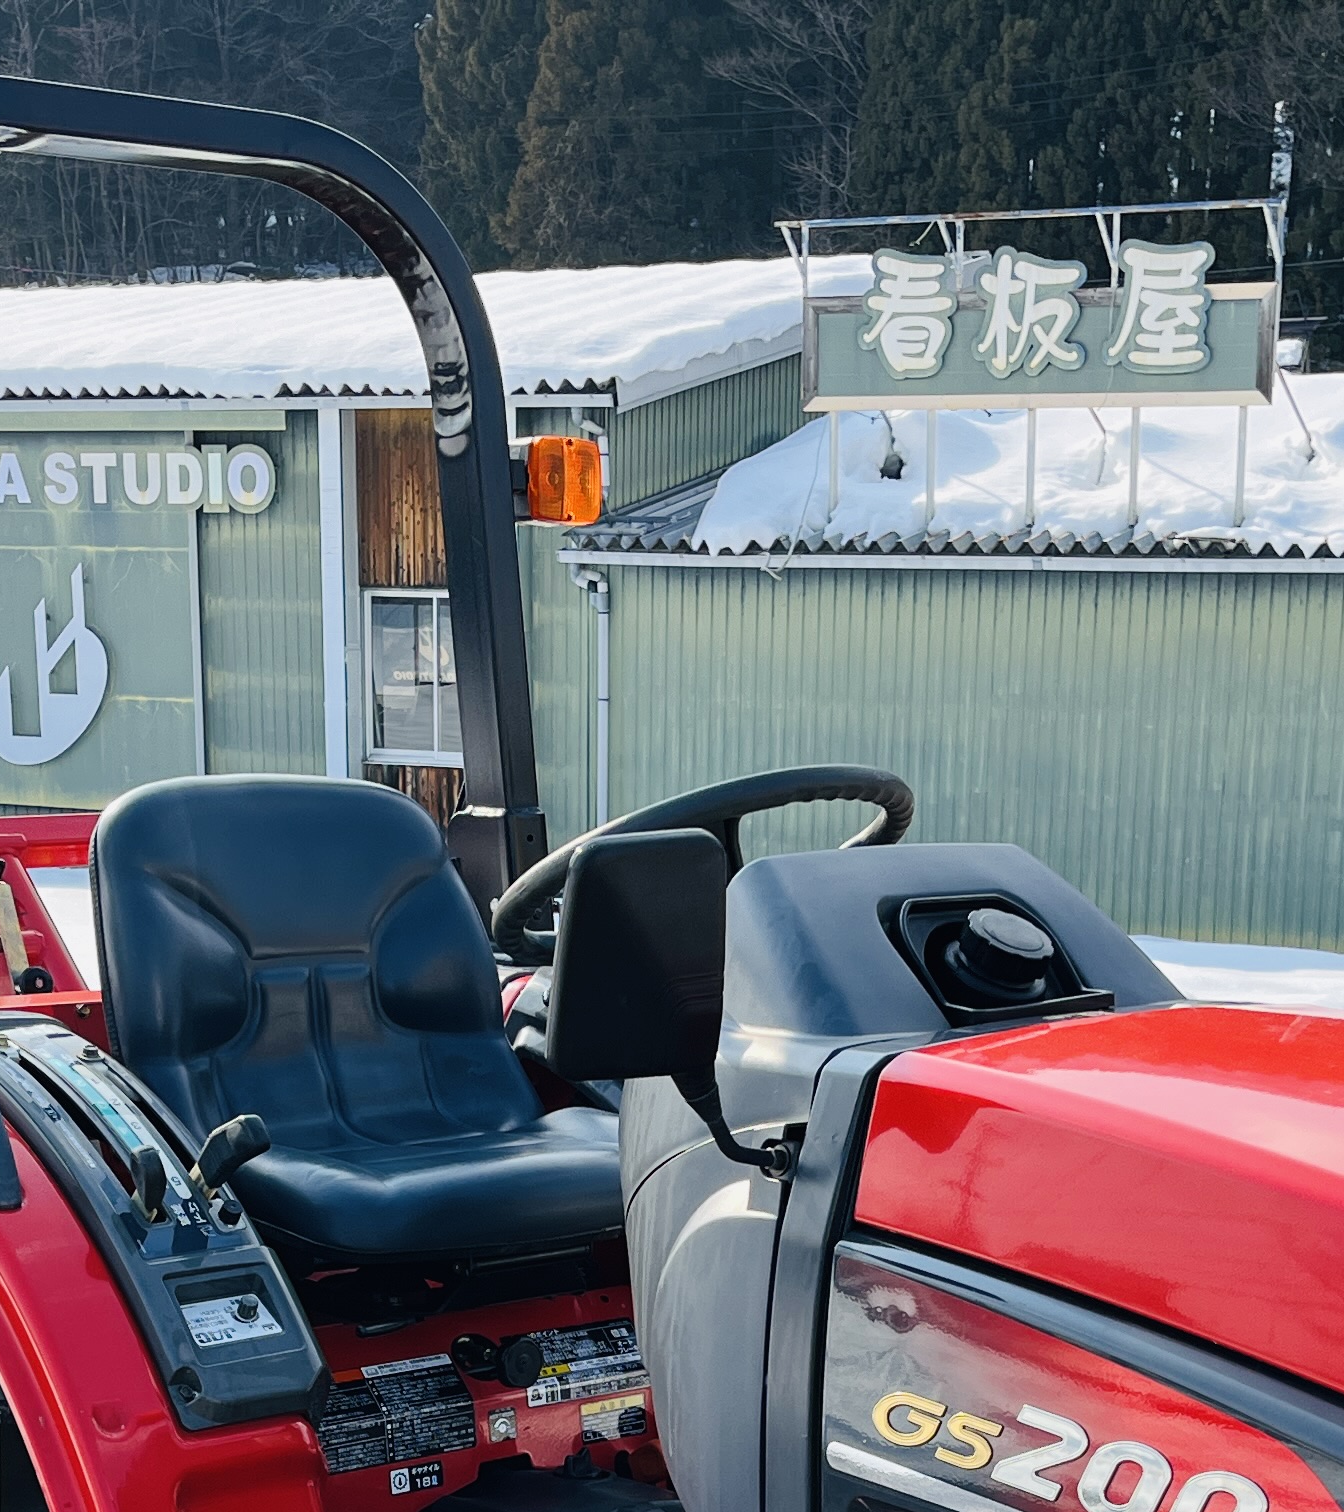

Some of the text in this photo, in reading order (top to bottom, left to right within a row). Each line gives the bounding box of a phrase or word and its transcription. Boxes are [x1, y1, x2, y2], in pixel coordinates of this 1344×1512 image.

[861, 246, 1207, 372] 看板屋
[44, 450, 271, 506] STUDIO
